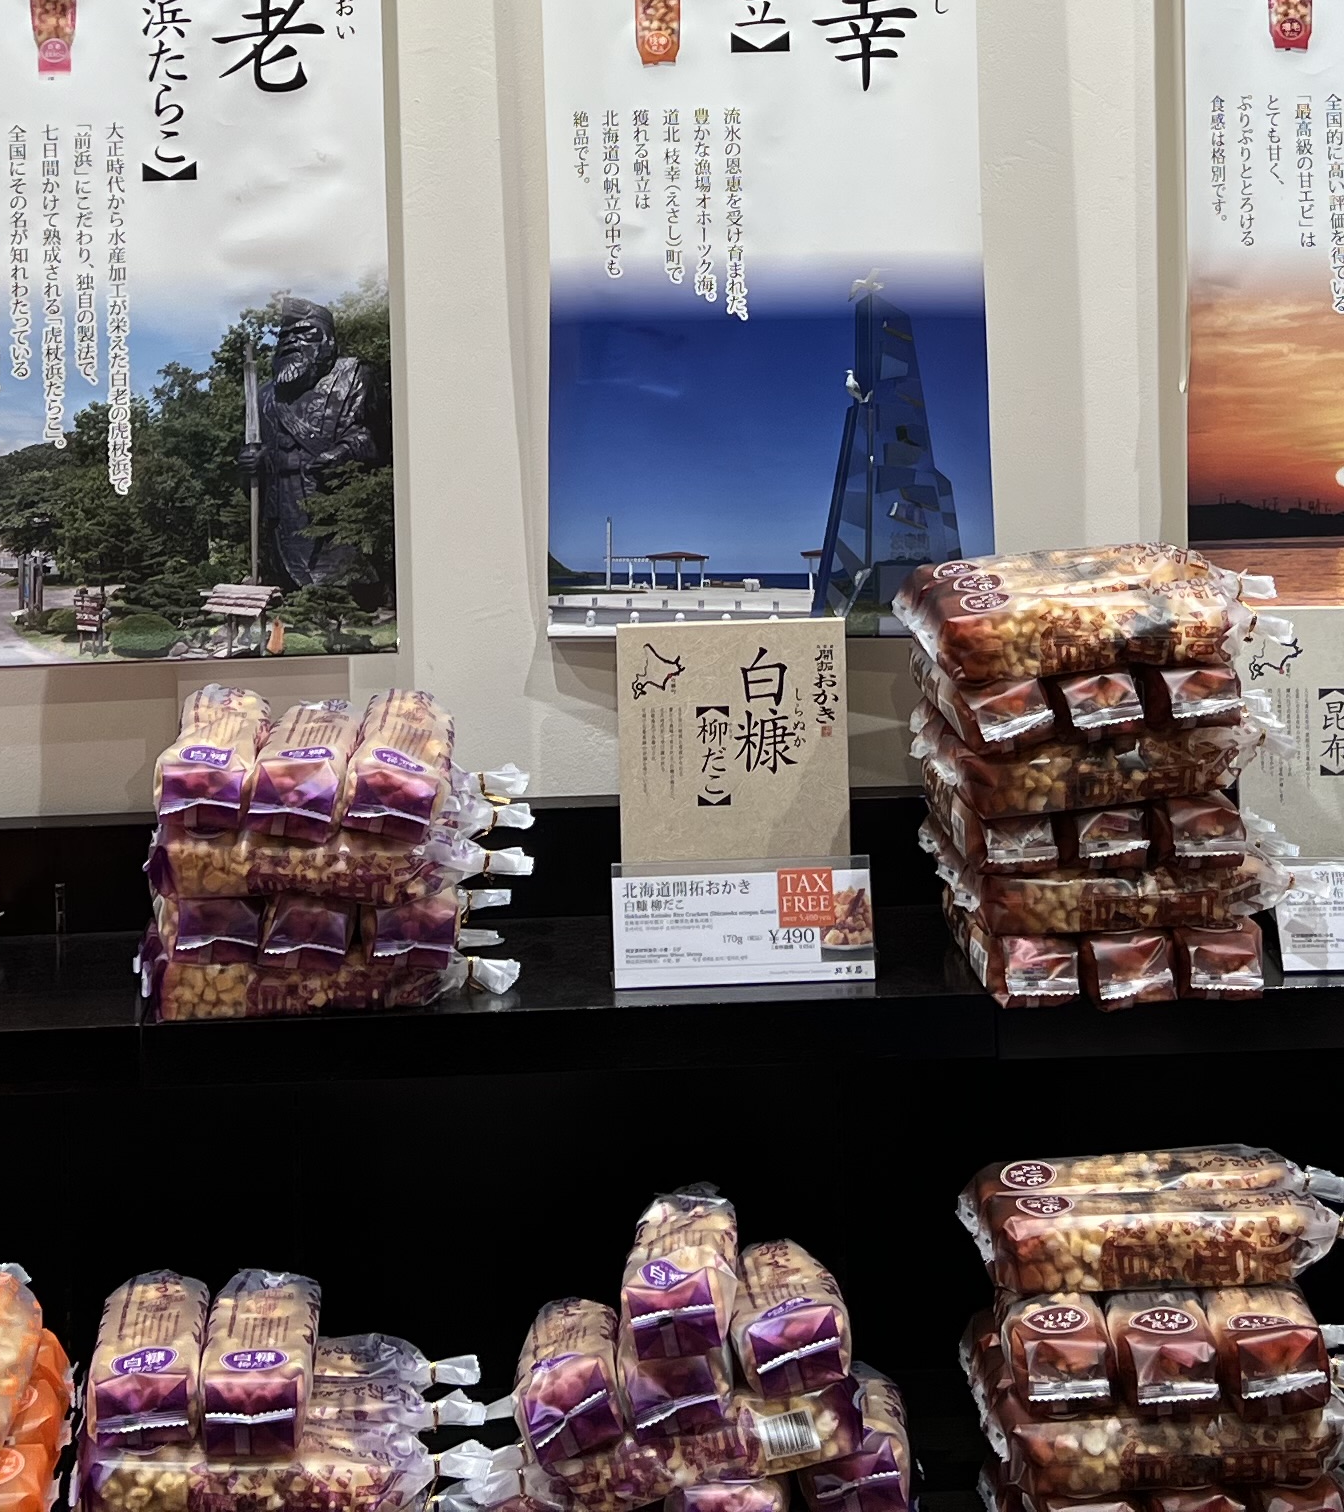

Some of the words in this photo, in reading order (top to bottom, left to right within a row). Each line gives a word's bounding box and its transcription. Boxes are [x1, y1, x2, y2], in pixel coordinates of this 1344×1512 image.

[572, 111, 590, 183] 絶品です。
[603, 110, 622, 276] 北海道の帆立の中でも
[633, 109, 650, 210] 獲れる帆立は
[1211, 95, 1227, 222] 食感は格別です。
[1237, 95, 1255, 247] ぷりぷりととろける
[1266, 95, 1284, 186] とても甘く、
[1295, 95, 1316, 248] 「最高級の甘エビ」は
[9, 125, 29, 378] 全国にその名が知れわたっている
[74, 122, 97, 385] 「前浜」にこだわり、独自の製法で、
[693, 107, 716, 300] 豊かな漁場オホーツク海。
[724, 107, 748, 319] 流氷の恩恵を受け育まれた、
[42, 124, 67, 448] 七日間かけて熟成される「虎杖浜たらこ」。
[106, 121, 129, 493] 大正時代から水産加工が栄えた白老の虎杖浜で
[696, 706, 731, 806] 【柳だこ】
[734, 647, 798, 774] 白糠
[792, 689, 806, 748] しらぬか
[622, 880, 751, 898] 北海道開拓おかき
[723, 935, 742, 944] 170g
[768, 928, 814, 944] ¥490
[781, 873, 829, 893] TAX
[783, 895, 831, 912] FREE
[1140, 1311, 1187, 1324] えりも
